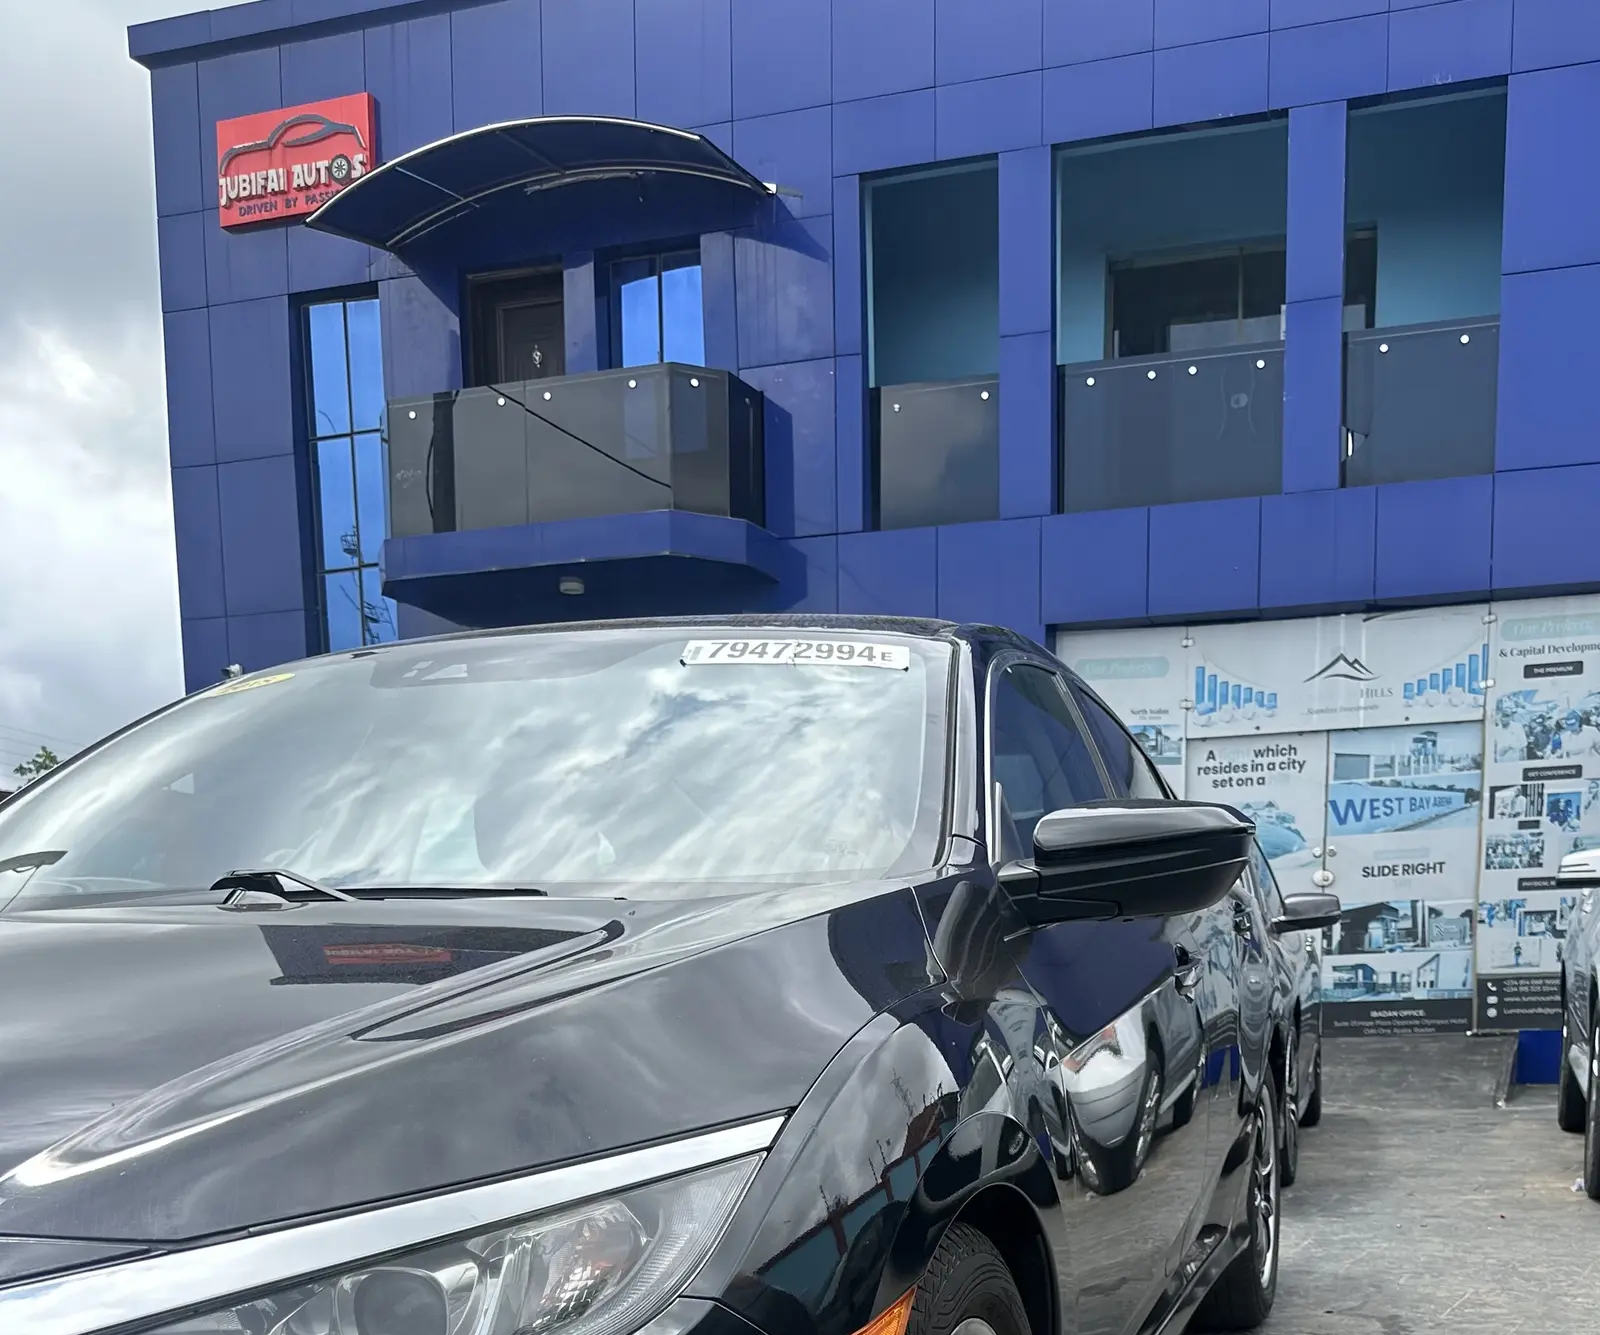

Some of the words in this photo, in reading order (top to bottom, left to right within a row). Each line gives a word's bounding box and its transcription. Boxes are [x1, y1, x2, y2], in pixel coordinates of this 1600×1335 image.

[218, 168, 288, 208] JUBIFAI
[292, 153, 367, 191] AUTOS
[238, 201, 278, 218] DRIVEN
[284, 197, 298, 210] BY
[1499, 648, 1508, 658] &
[1510, 645, 1545, 658] Capital
[1205, 750, 1217, 762] A
[1253, 744, 1298, 759] which
[1196, 762, 1249, 776] resides
[1250, 759, 1265, 773] in
[1266, 760, 1276, 772] a
[1278, 757, 1307, 774] city
[1211, 777, 1234, 789] set
[1235, 777, 1254, 787] on
[1256, 776, 1266, 787] a
[1328, 797, 1405, 826] WEST
[1408, 796, 1431, 812] BAY
[1361, 864, 1400, 878] SLIDE
[1401, 861, 1446, 876] RIGHT
